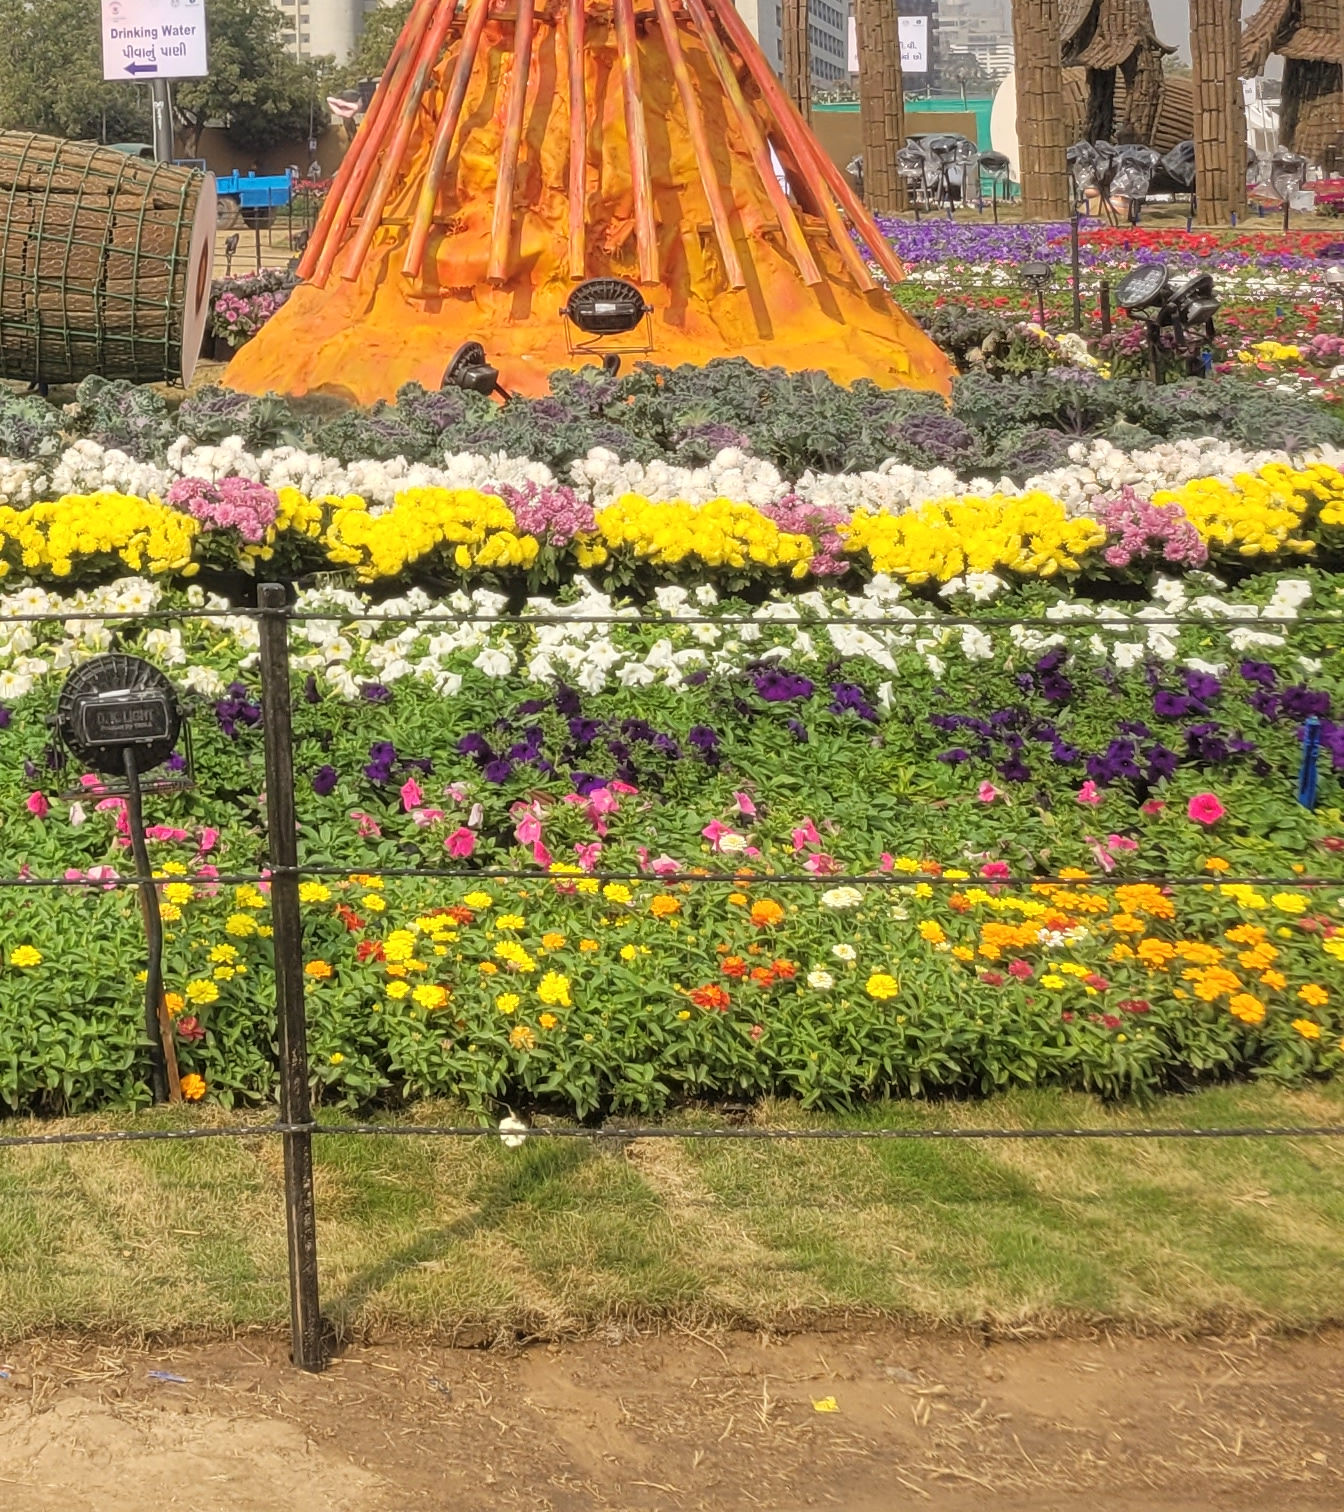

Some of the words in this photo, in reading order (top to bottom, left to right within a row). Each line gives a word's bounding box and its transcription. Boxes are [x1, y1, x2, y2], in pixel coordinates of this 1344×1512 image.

[110, 27, 158, 39] Drinking
[161, 25, 196, 37] Water
[122, 44, 157, 62] પીવાનું
[160, 42, 187, 56] પાણી
